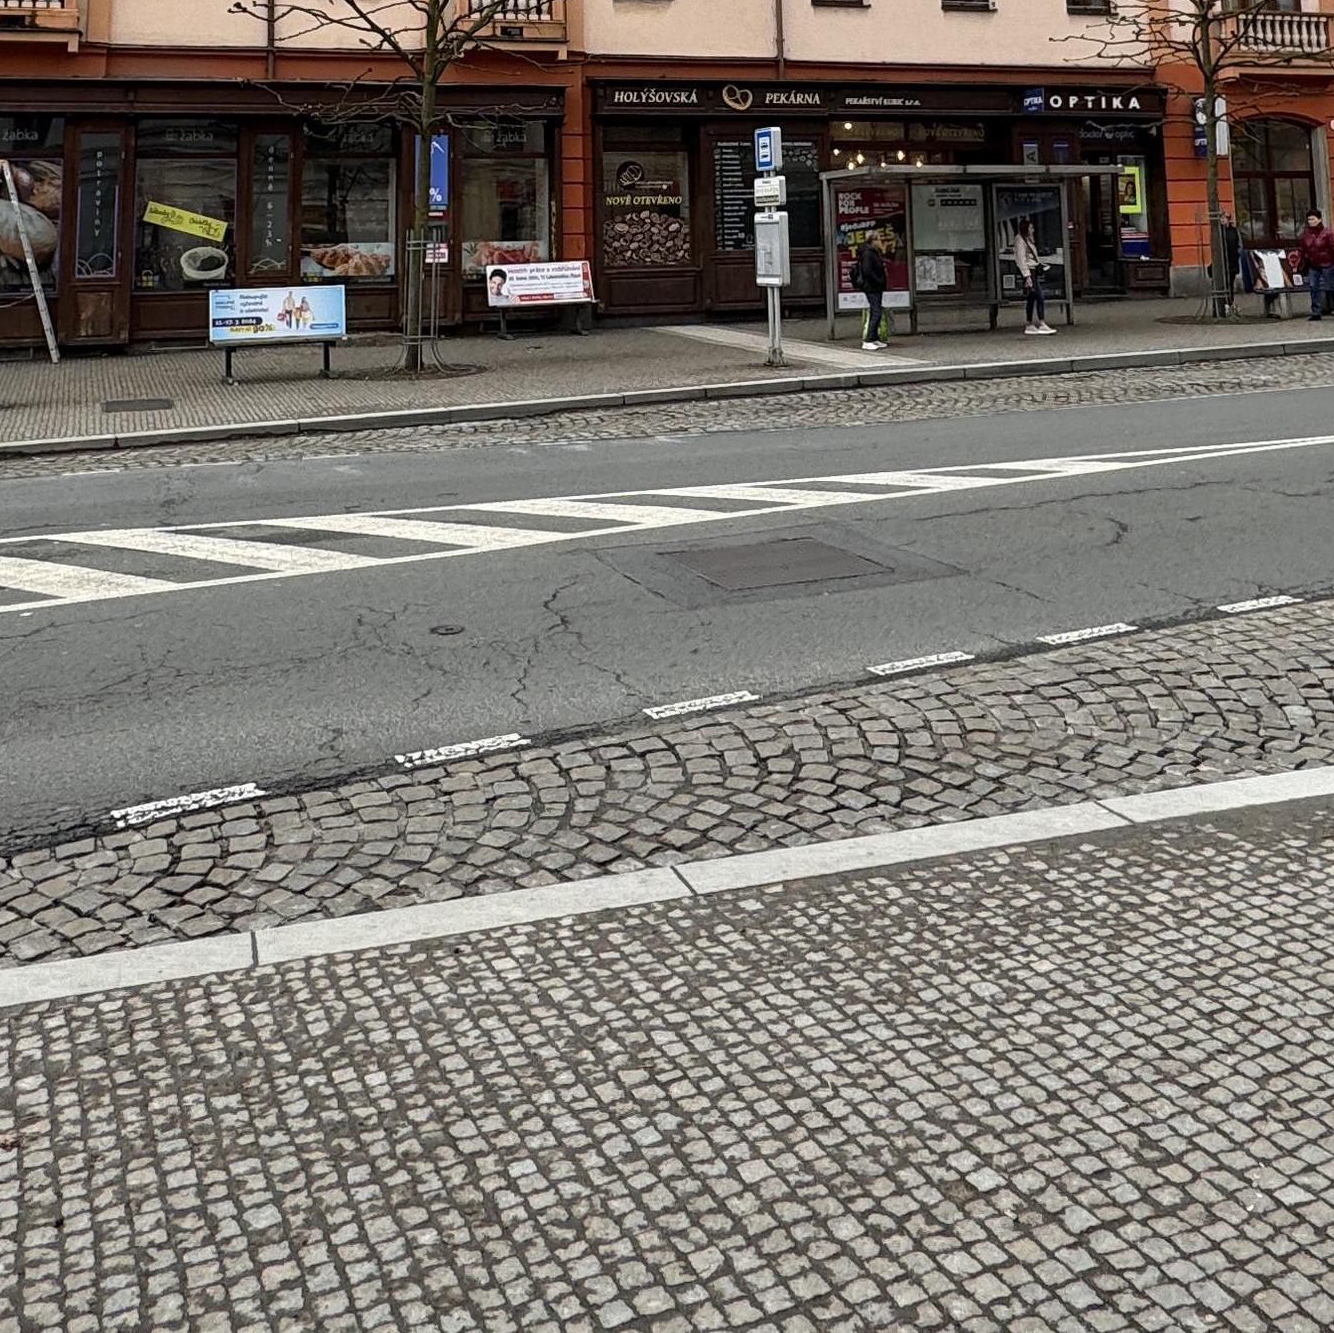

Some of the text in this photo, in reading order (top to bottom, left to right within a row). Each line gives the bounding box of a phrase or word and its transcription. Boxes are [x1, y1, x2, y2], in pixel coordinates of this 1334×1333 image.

[613, 87, 821, 106] HOLÝŠOVSKÁ PEKÁRNA
[1049, 94, 1141, 110] OPTIKA
[632, 195, 683, 207] OTEVŘENO
